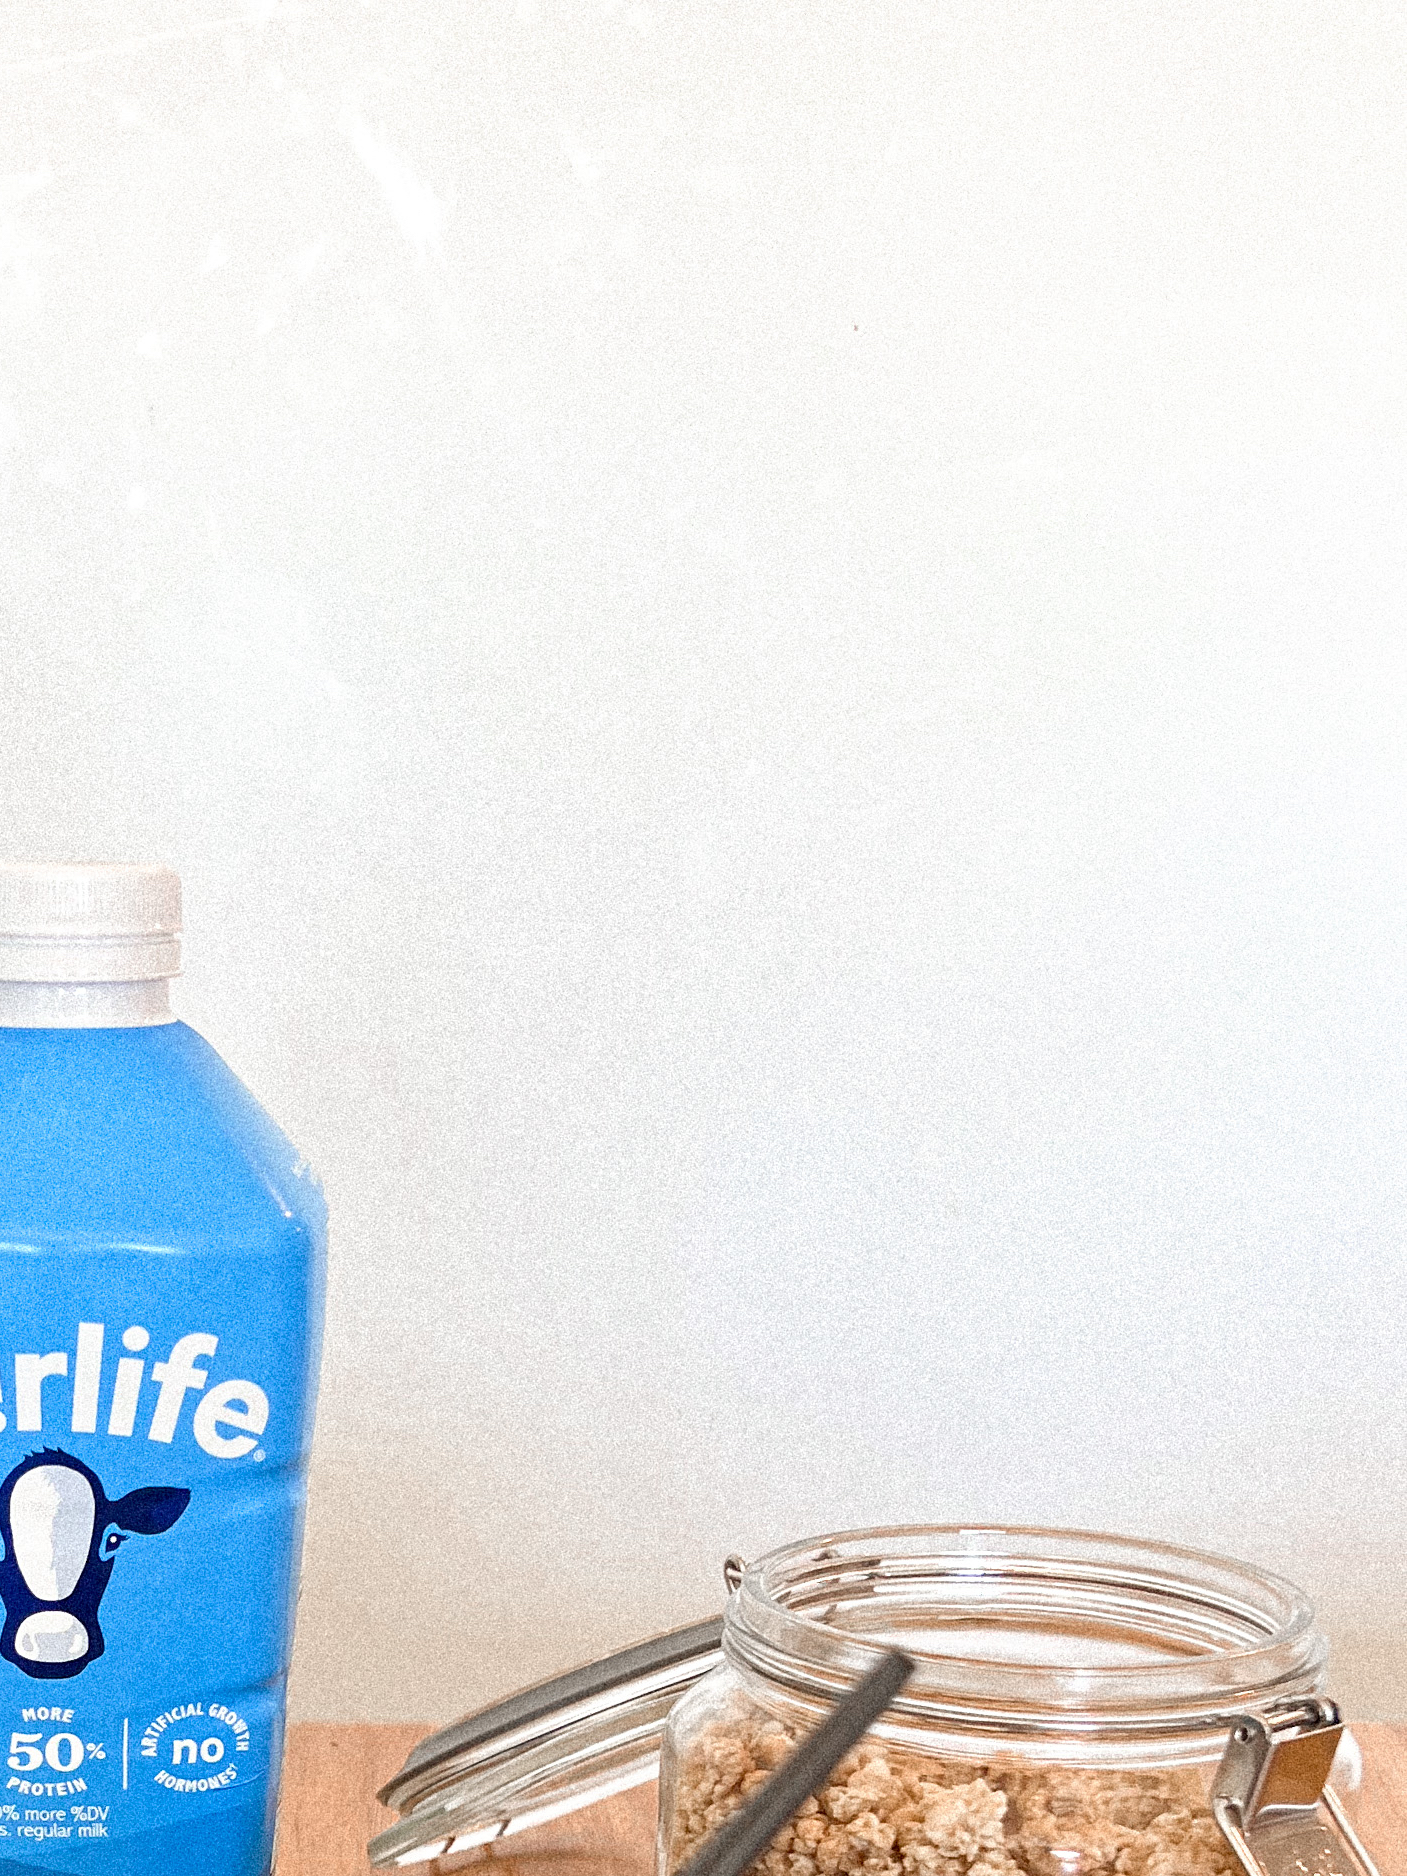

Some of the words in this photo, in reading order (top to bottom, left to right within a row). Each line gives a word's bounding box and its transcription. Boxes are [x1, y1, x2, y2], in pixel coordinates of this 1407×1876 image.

[22, 1706, 75, 1723] MORE
[140, 1702, 205, 1757] ARTIFICIAL
[208, 1703, 250, 1752] GROWTH
[6, 1731, 107, 1773] 50%
[171, 1736, 225, 1765] no
[5, 1776, 88, 1797] PROTEIN
[24, 1809, 67, 1821] more
[70, 1805, 110, 1822] %DV
[17, 1822, 73, 1841] regular
[78, 1822, 110, 1838] milk
